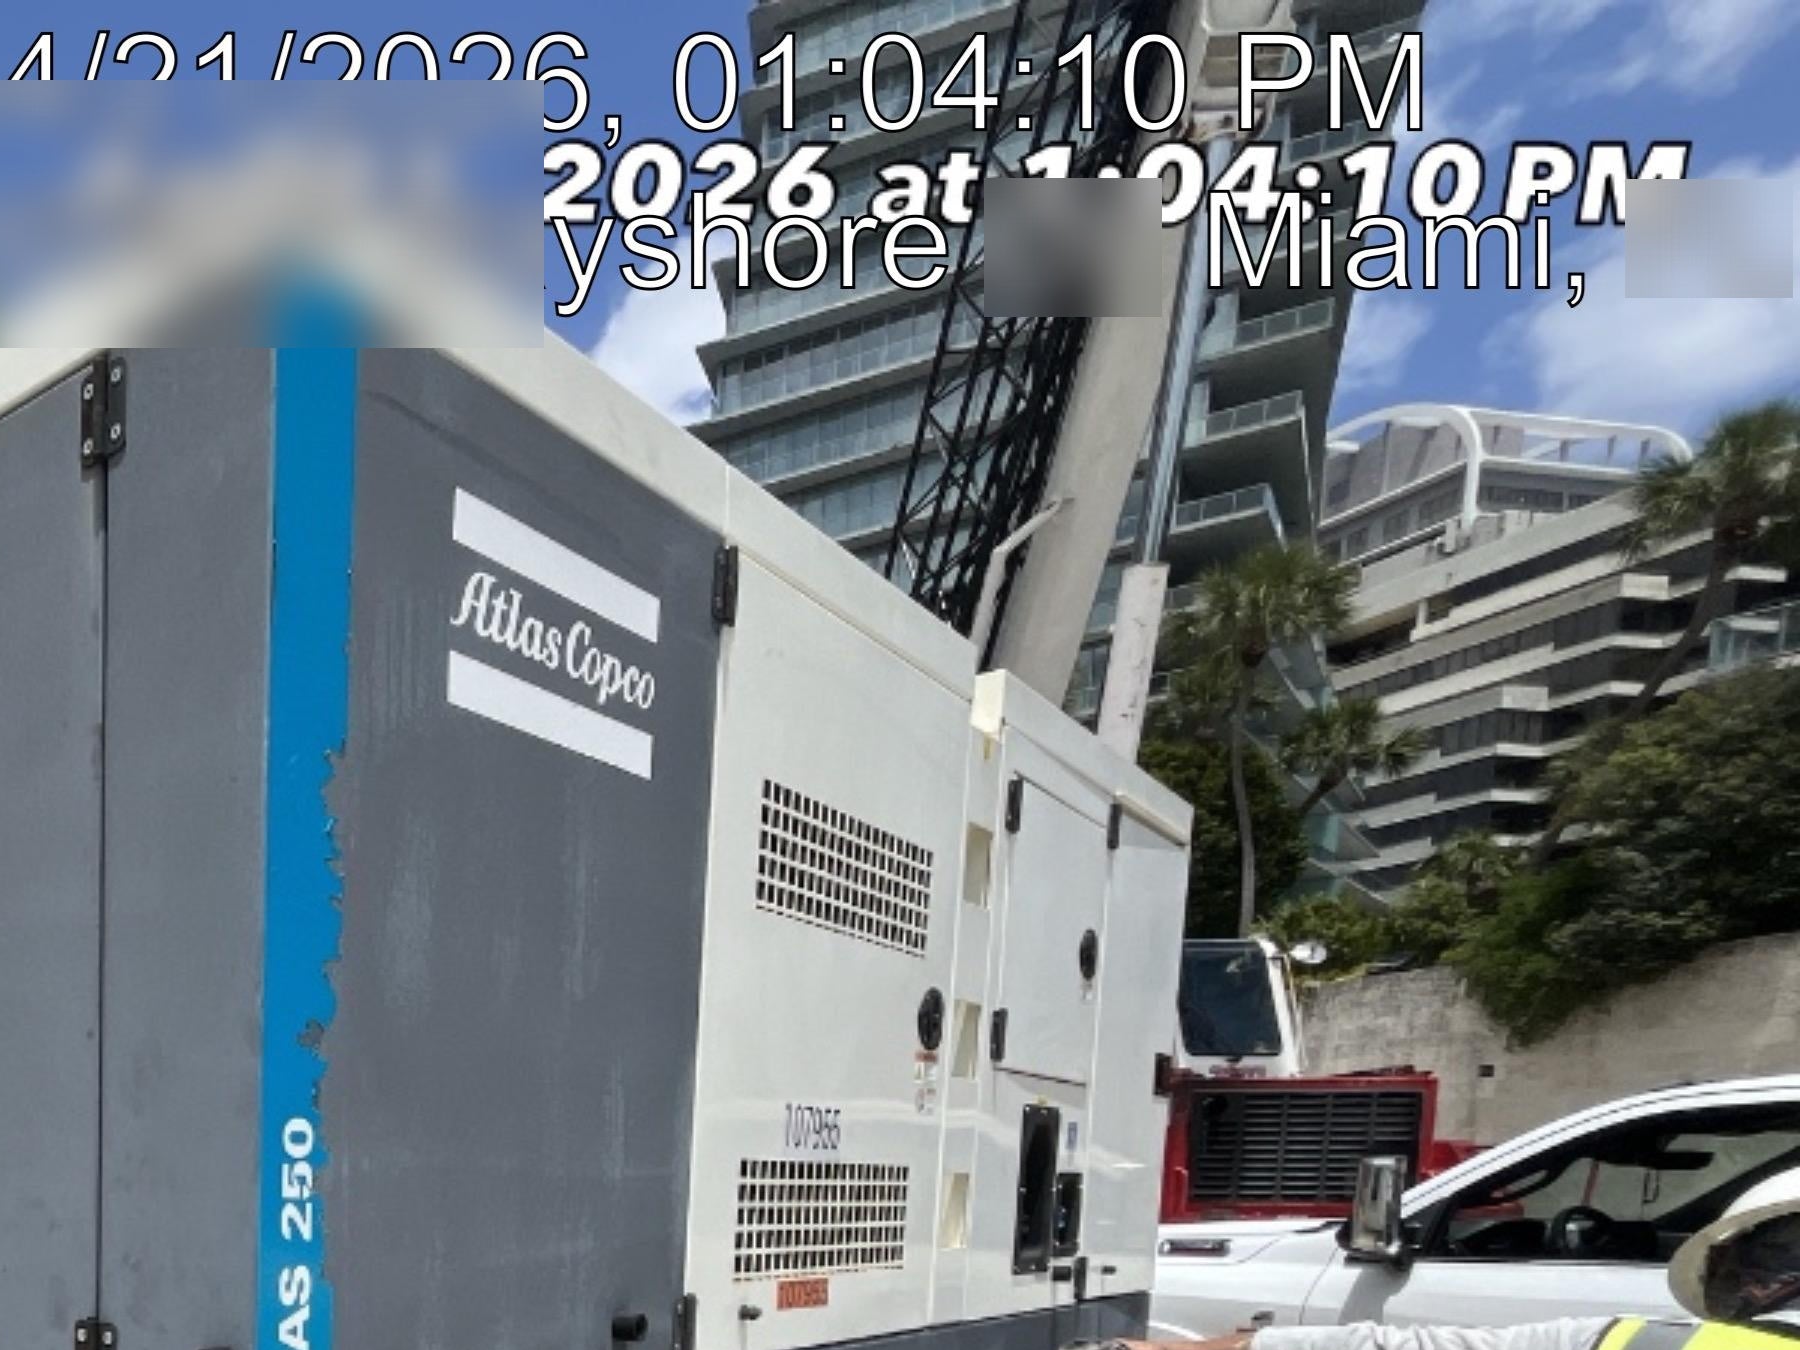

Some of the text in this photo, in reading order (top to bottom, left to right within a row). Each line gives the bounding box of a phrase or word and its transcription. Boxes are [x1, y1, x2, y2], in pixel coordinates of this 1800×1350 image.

[450, 571, 655, 710] Atlas Copco
[280, 1116, 315, 1243] 250
